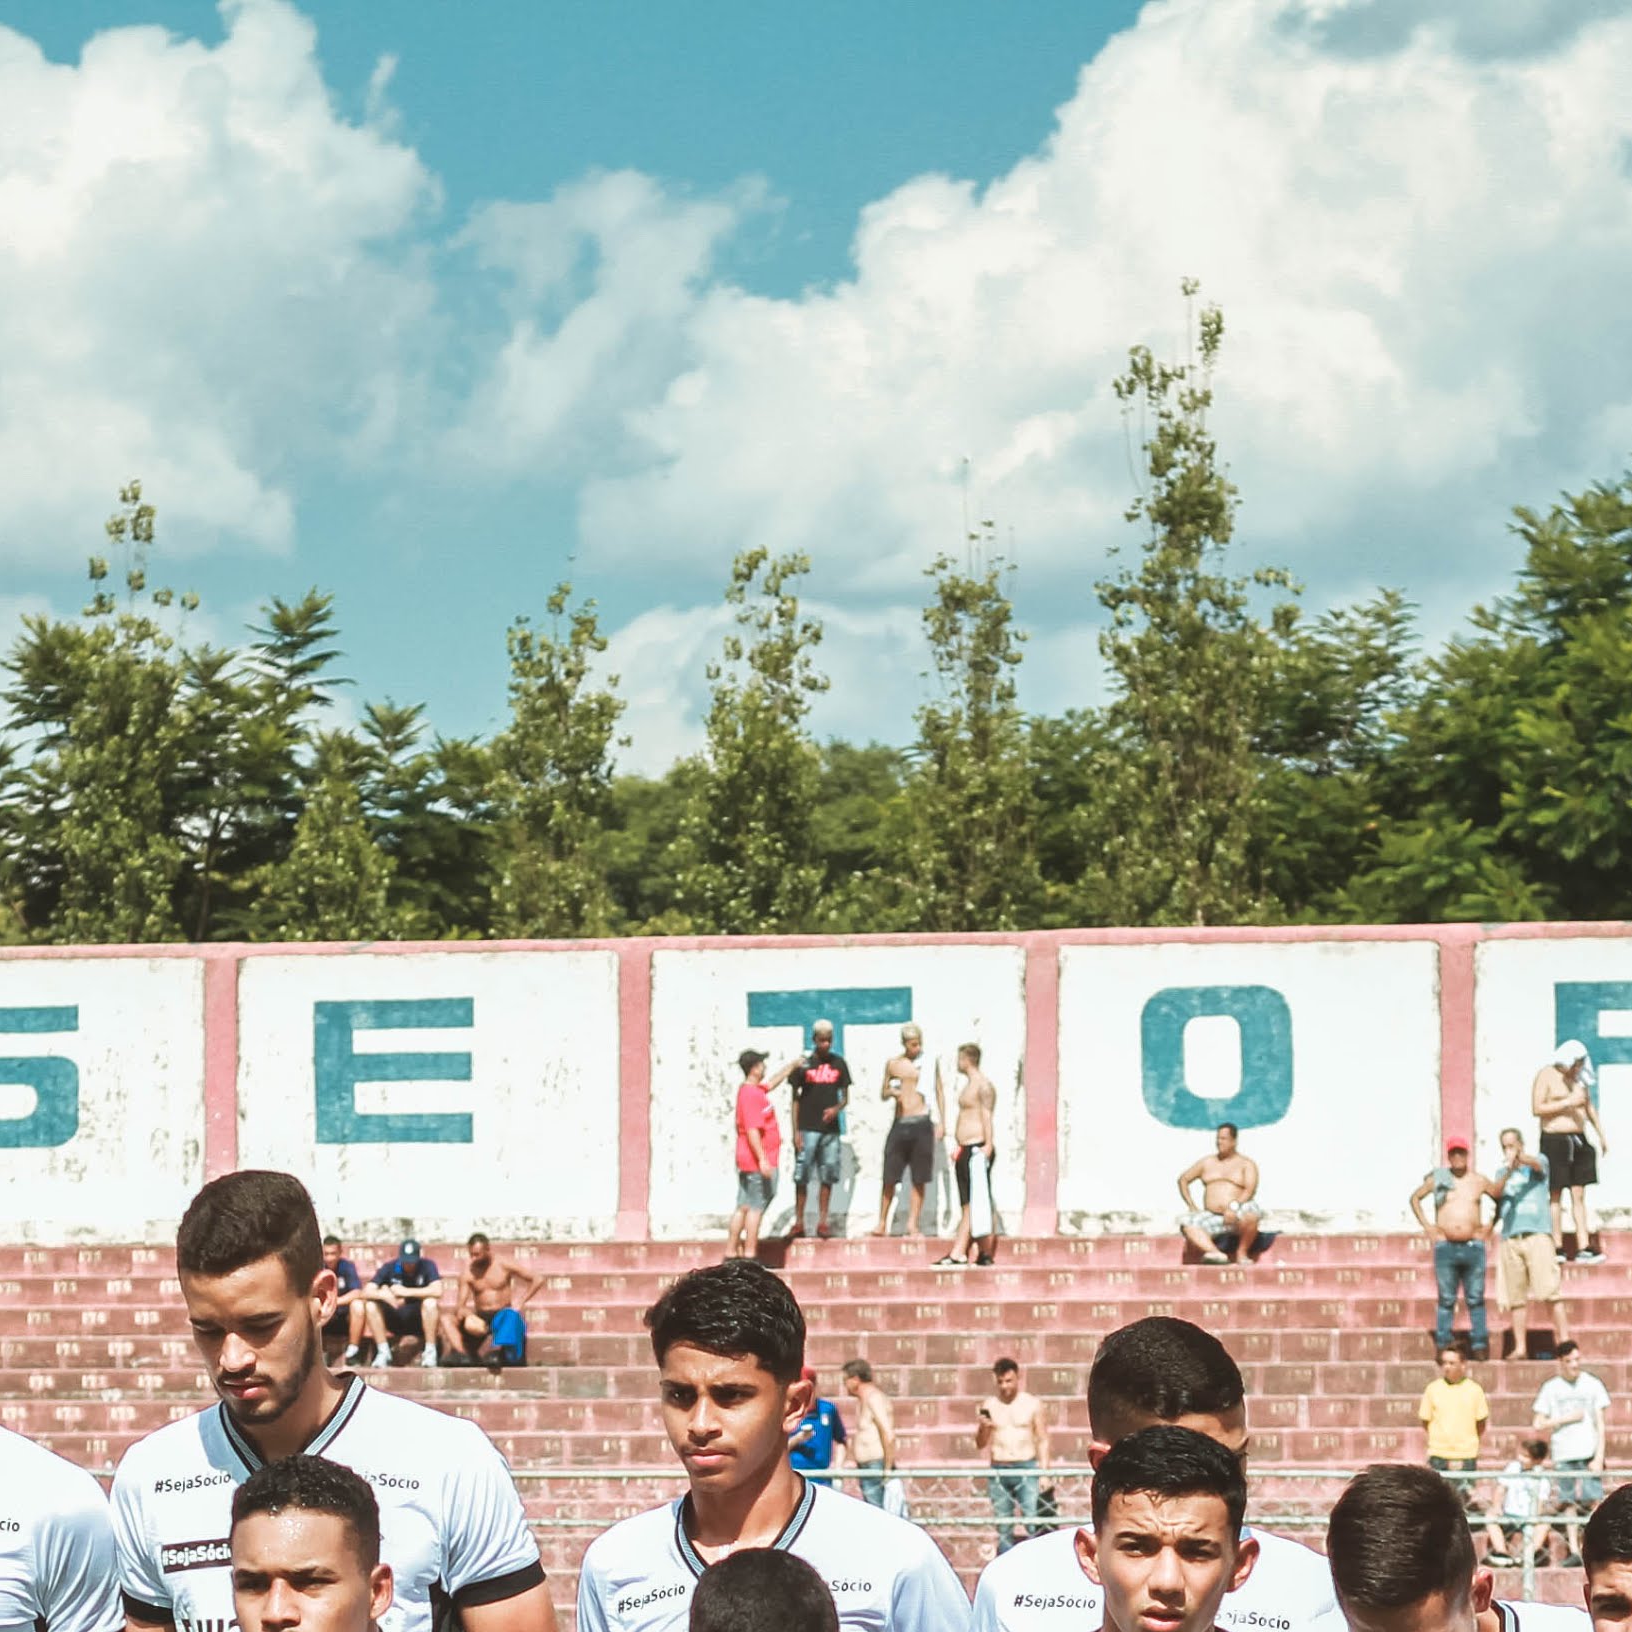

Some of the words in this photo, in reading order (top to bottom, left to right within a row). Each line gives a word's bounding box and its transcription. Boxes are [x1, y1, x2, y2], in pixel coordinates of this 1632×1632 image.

[154, 1473, 232, 1494] #SejaSócio
[617, 1583, 686, 1614] #SejaSócio
[1013, 1593, 1097, 1611] #SejaSócio
